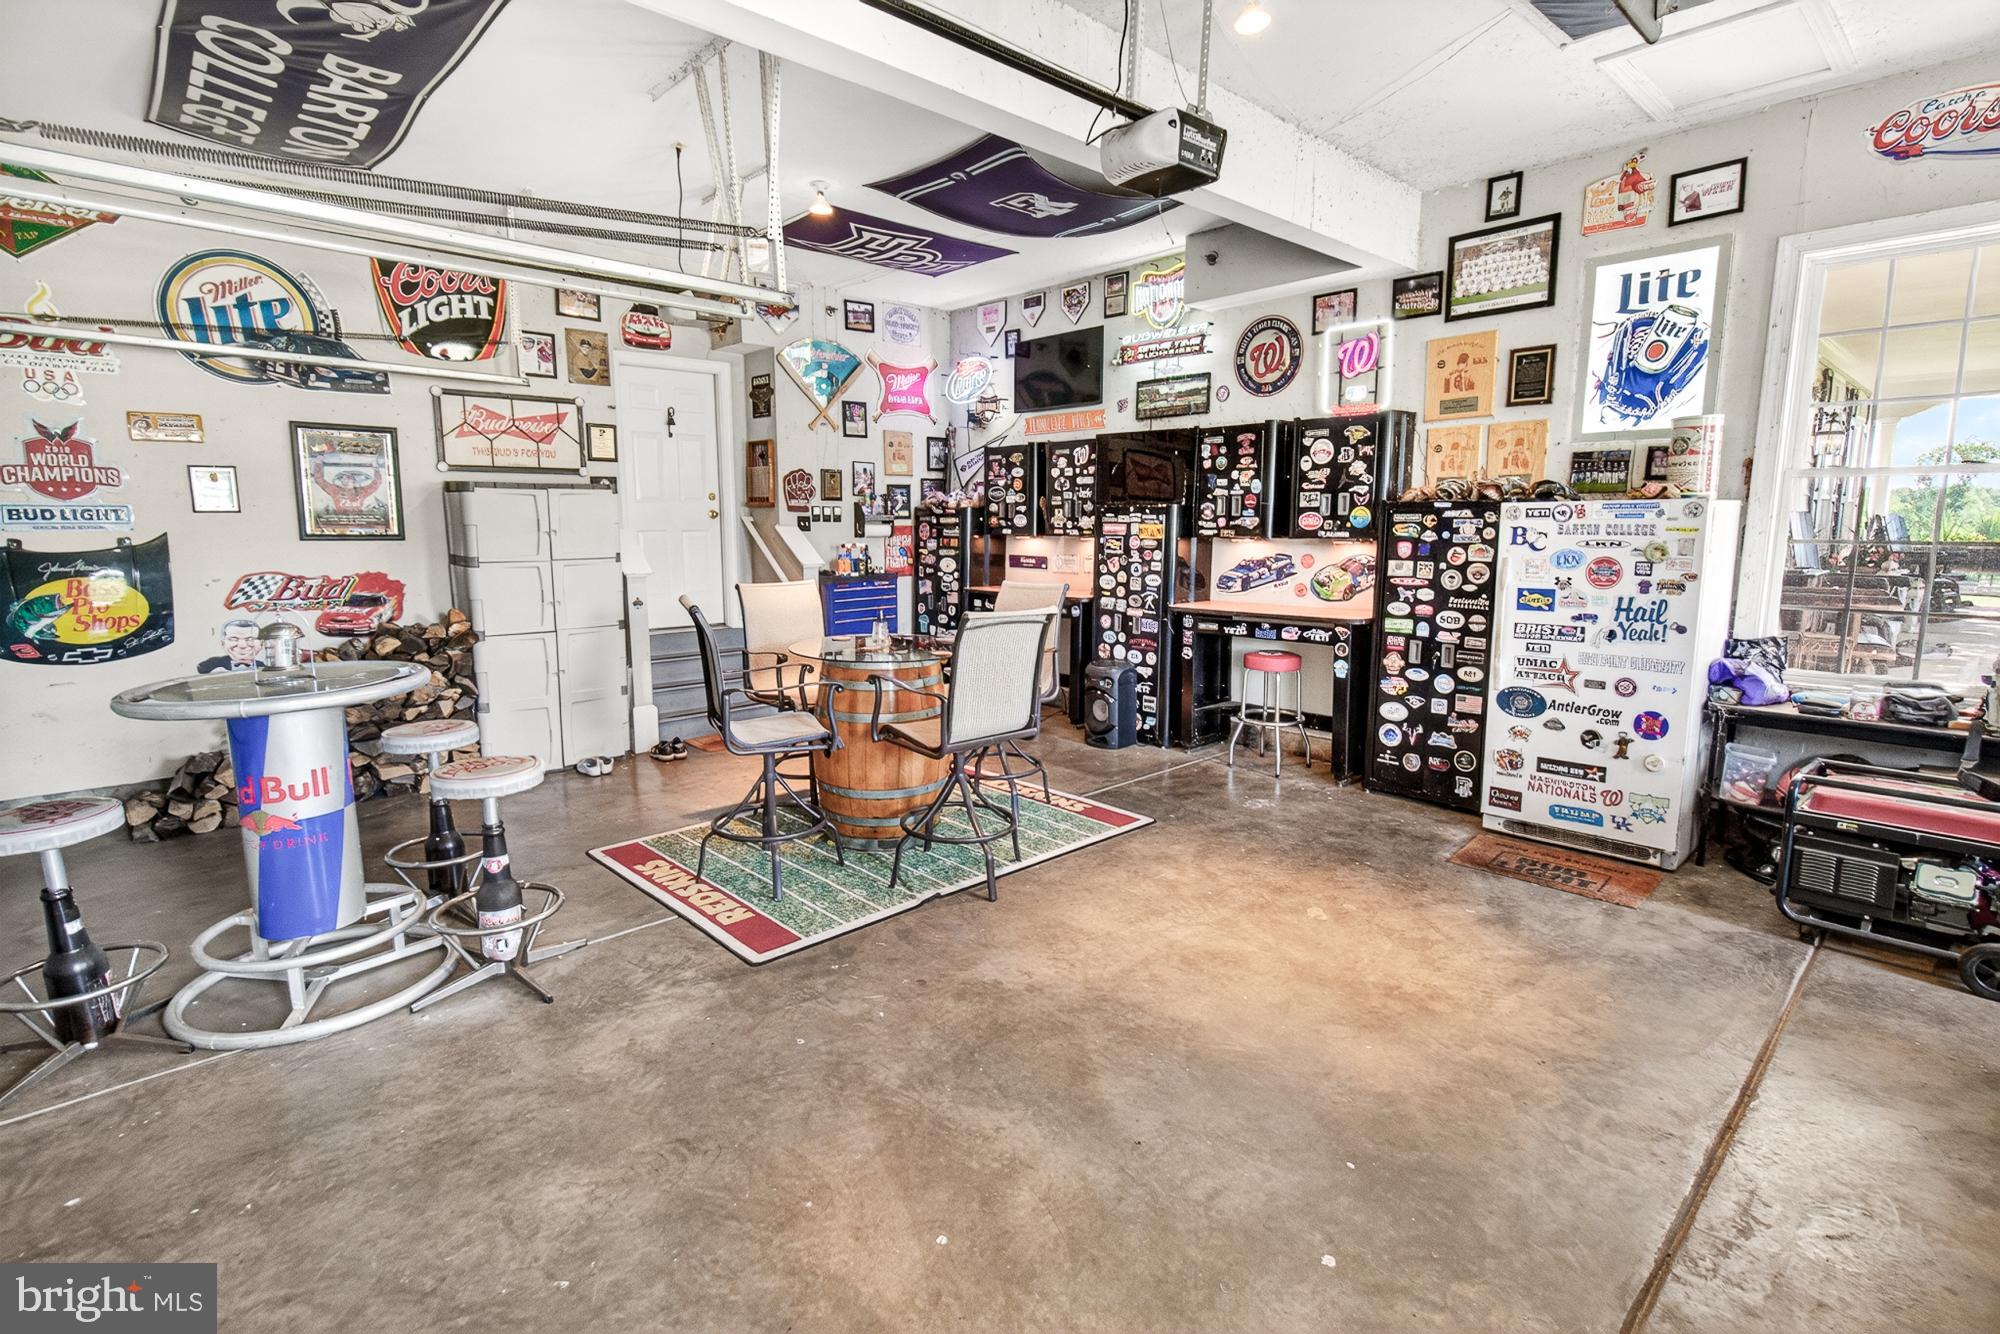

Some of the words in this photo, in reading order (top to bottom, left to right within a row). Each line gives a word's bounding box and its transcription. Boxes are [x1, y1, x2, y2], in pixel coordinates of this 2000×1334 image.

[179, 14, 293, 146] COLLEGE
[279, 52, 403, 161] BARTON
[199, 275, 264, 304] Miller
[380, 261, 497, 305] Coors
[1616, 267, 1702, 314] Lite
[398, 294, 494, 337] LIGHT
[1654, 316, 1688, 338] Lite
[30, 452, 89, 468] WORLD
[2, 466, 121, 487] CHAMPIONS
[6, 508, 57, 521] BUD
[60, 508, 126, 521] LIGHT
[1526, 508, 1550, 518] YETI
[1557, 523, 1600, 536] BARTON
[1604, 523, 1657, 537] COLLEGE
[272, 575, 351, 601] Bud
[71, 597, 110, 616] Pro
[1614, 597, 1669, 625] Hail
[72, 612, 140, 634] Shops
[1617, 621, 1668, 643] Yeah!
[1528, 643, 1550, 653] YETI
[1516, 657, 1558, 669] UMAC
[1516, 670, 1566, 683] ATTACK
[1547, 699, 1623, 719] AntlerGrow
[1595, 717, 1621, 727] .com
[259, 766, 331, 805] Bull
[1525, 780, 1598, 804] NATIONALS
[1528, 774, 1597, 793] WASHINGTON
[1553, 805, 1601, 820] TRUMP
[633, 859, 756, 927] REDSKINS
